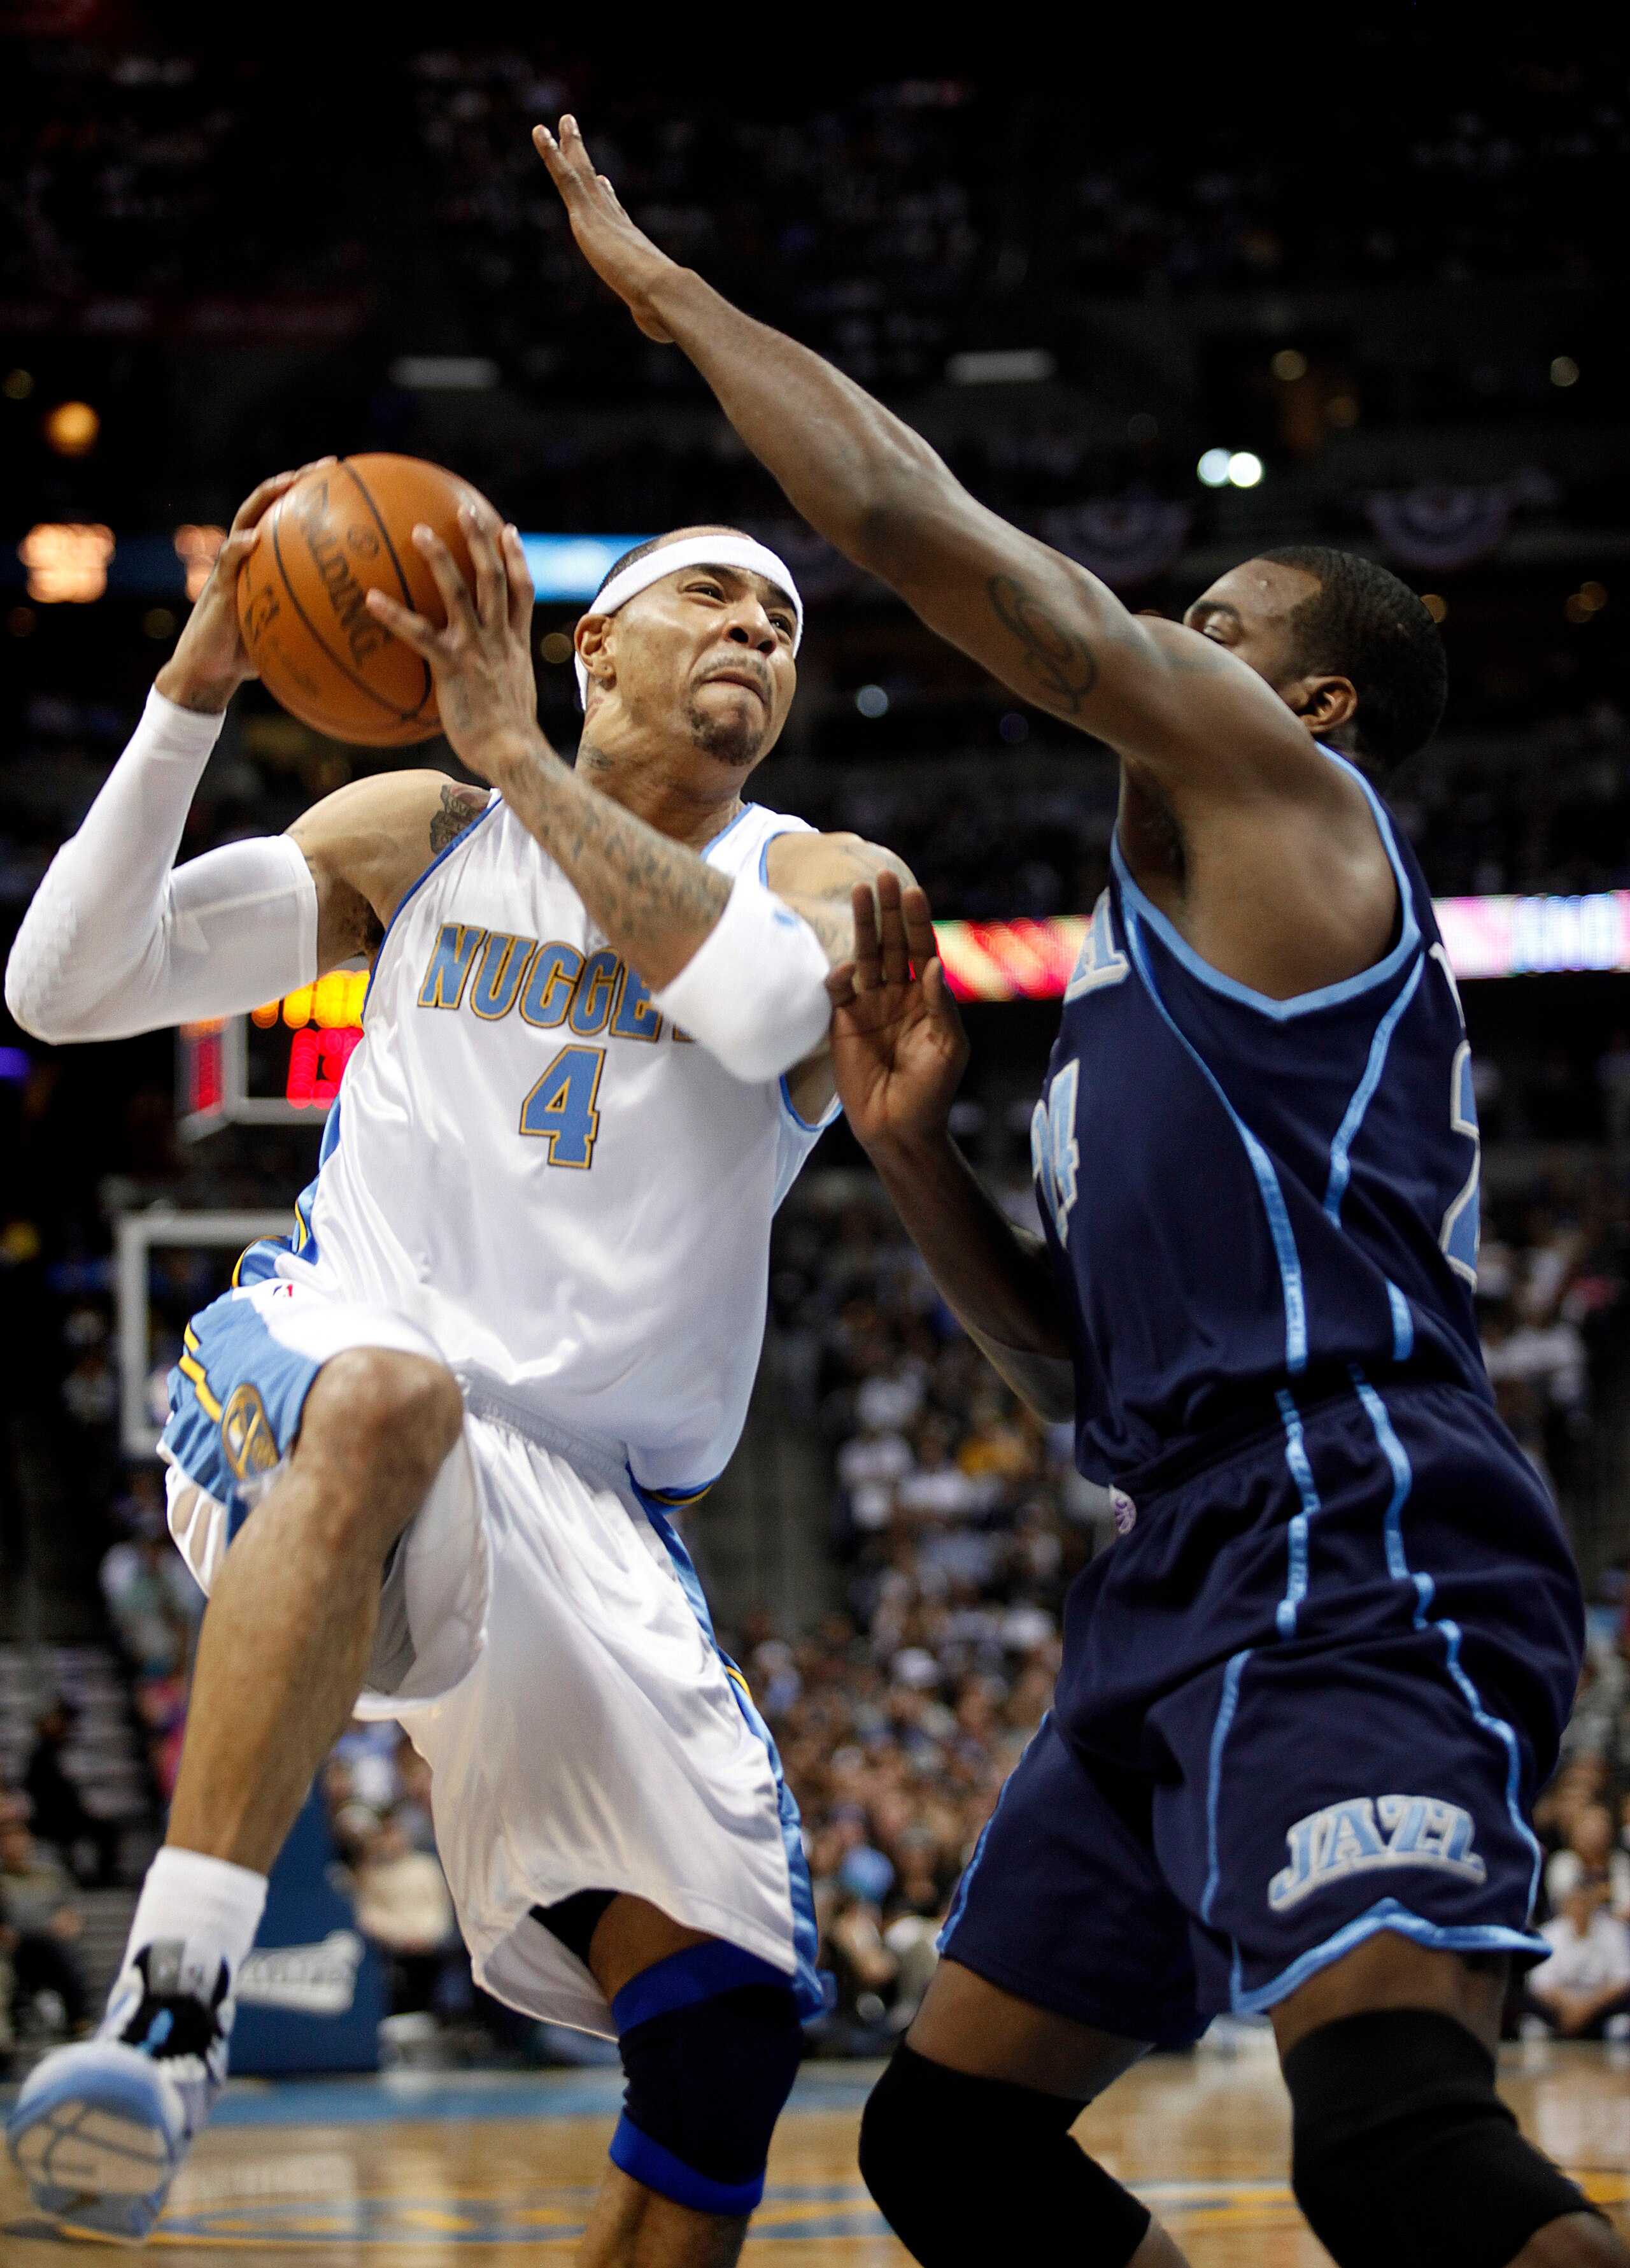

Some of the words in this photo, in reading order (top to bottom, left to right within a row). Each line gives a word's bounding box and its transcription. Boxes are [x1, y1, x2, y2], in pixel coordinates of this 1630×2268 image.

[298, 480, 396, 667] LDING
[418, 922, 694, 1043] NUGGE
[520, 1043, 606, 1169] 4
[1268, 1794, 1488, 1913] JAZZ
